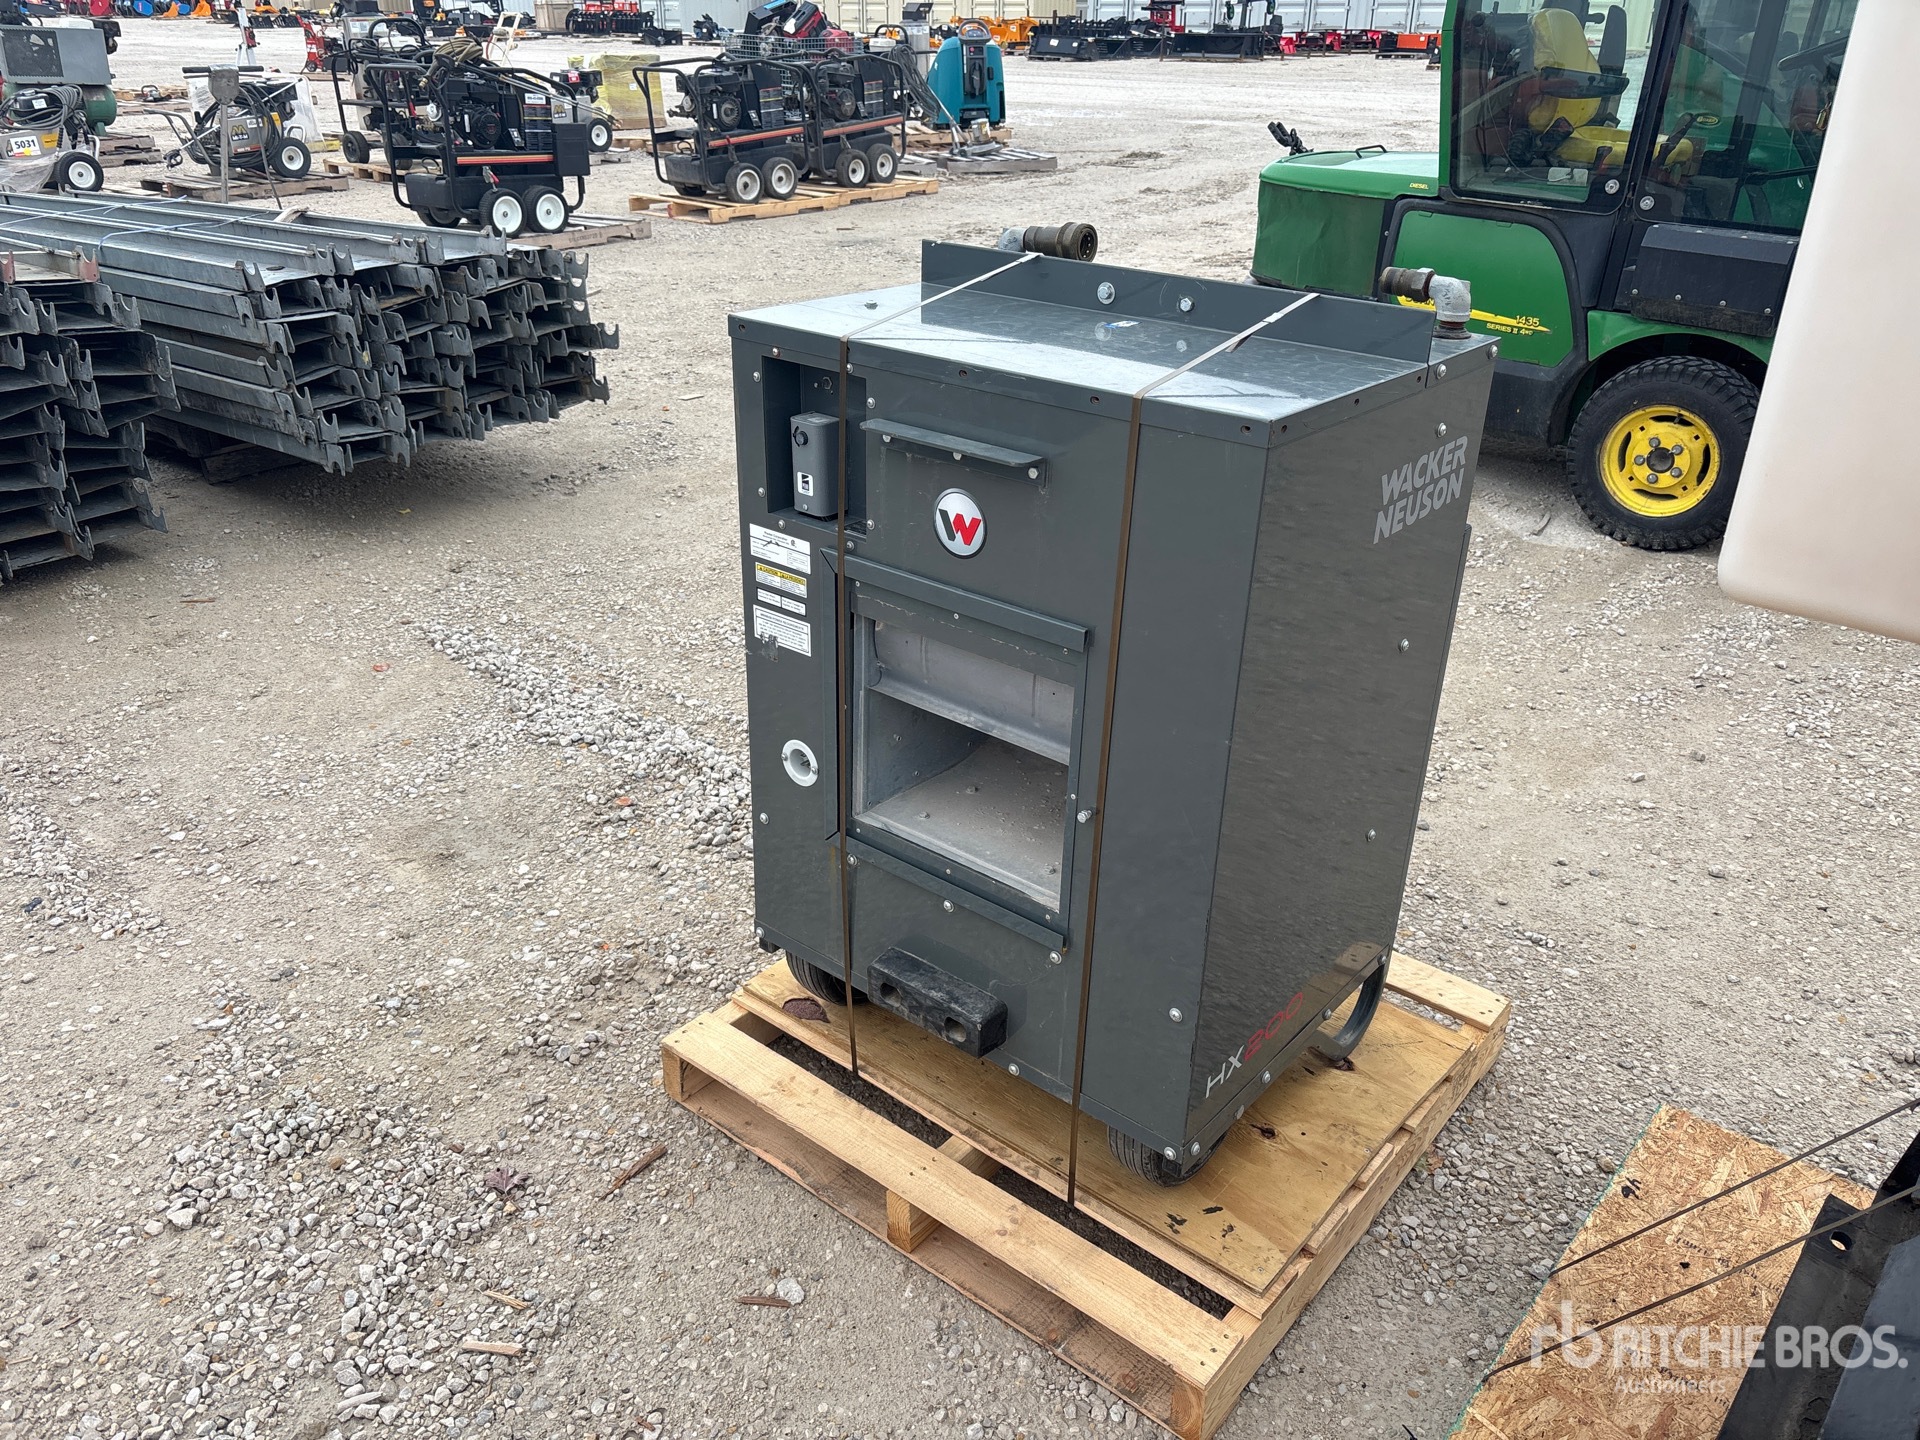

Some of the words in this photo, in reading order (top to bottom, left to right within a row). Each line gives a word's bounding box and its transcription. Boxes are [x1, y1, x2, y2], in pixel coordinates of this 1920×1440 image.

[14, 139, 36, 149] 5031
[1409, 182, 1429, 190] DIESEL
[1516, 315, 1539, 327] 1435
[1486, 322, 1512, 333] SERIES
[1381, 436, 1468, 505] WACKER
[1373, 468, 1465, 545] NEUSON
[1205, 992, 1303, 1098] HX200
